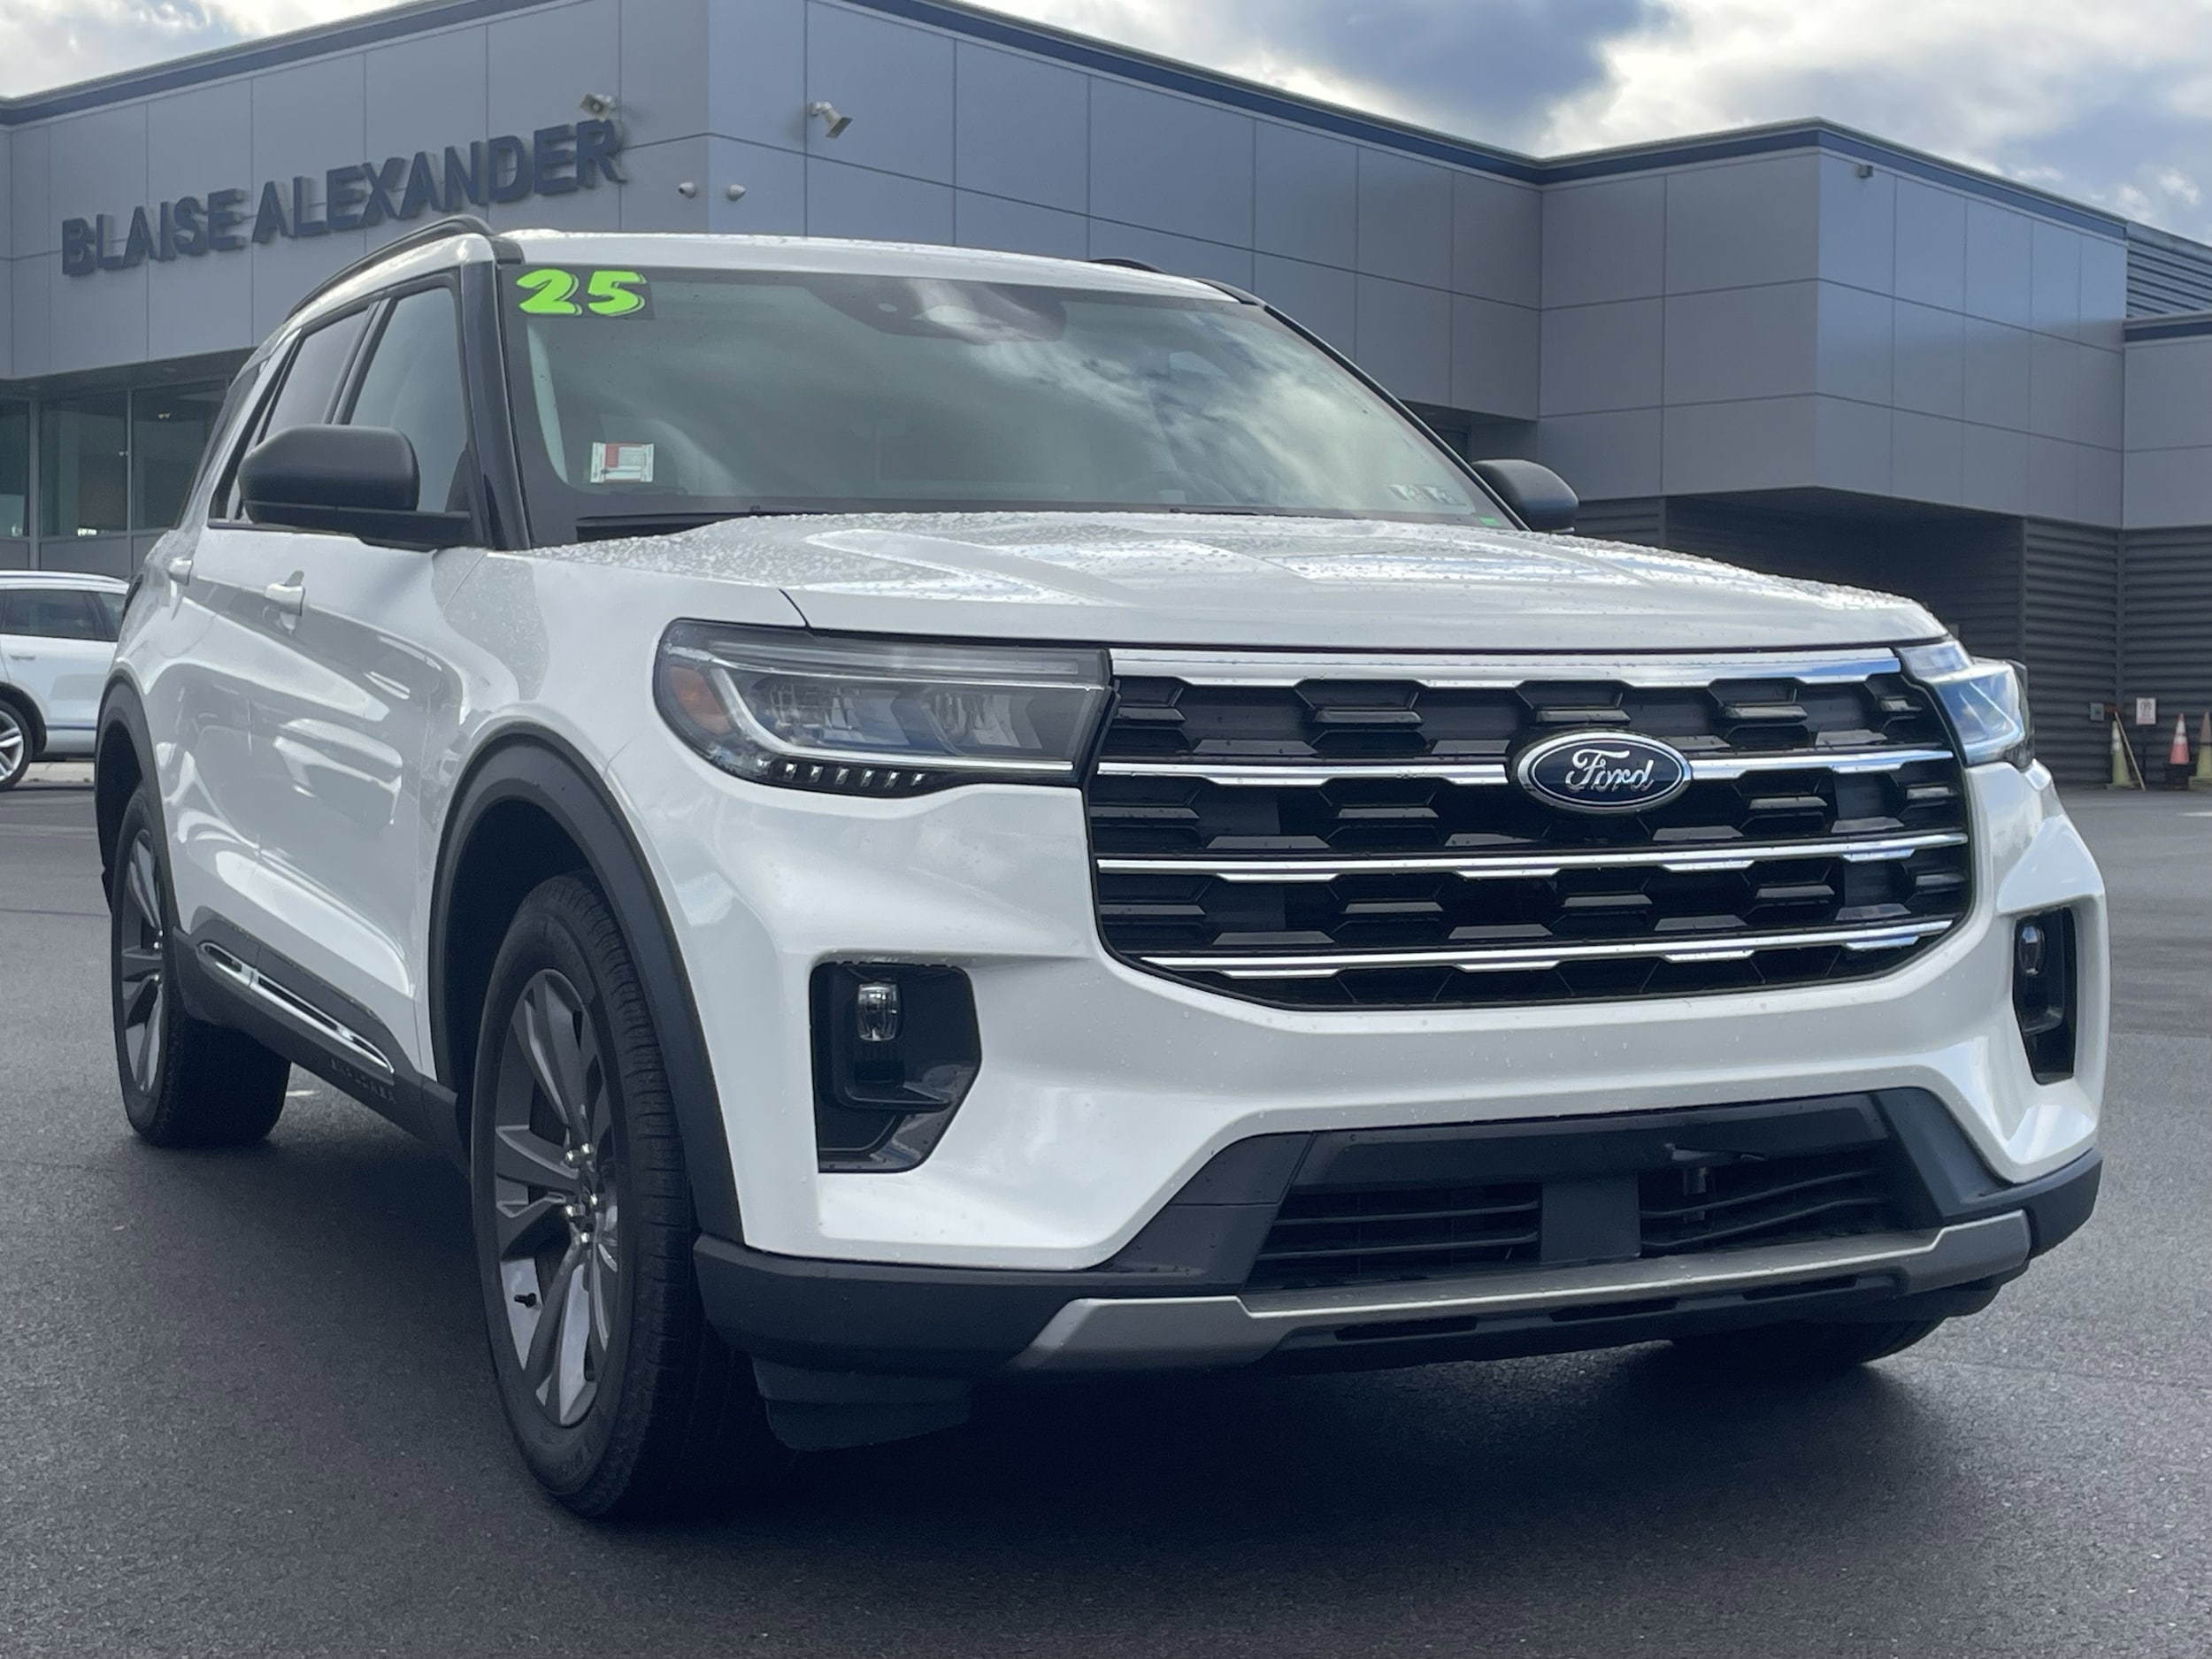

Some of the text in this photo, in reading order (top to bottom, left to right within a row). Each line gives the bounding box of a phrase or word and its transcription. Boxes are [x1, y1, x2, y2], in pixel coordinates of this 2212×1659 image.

[61, 119, 625, 276] BLAISE ALEXANDER
[517, 269, 647, 316] 25
[1565, 749, 1655, 792] Ford
